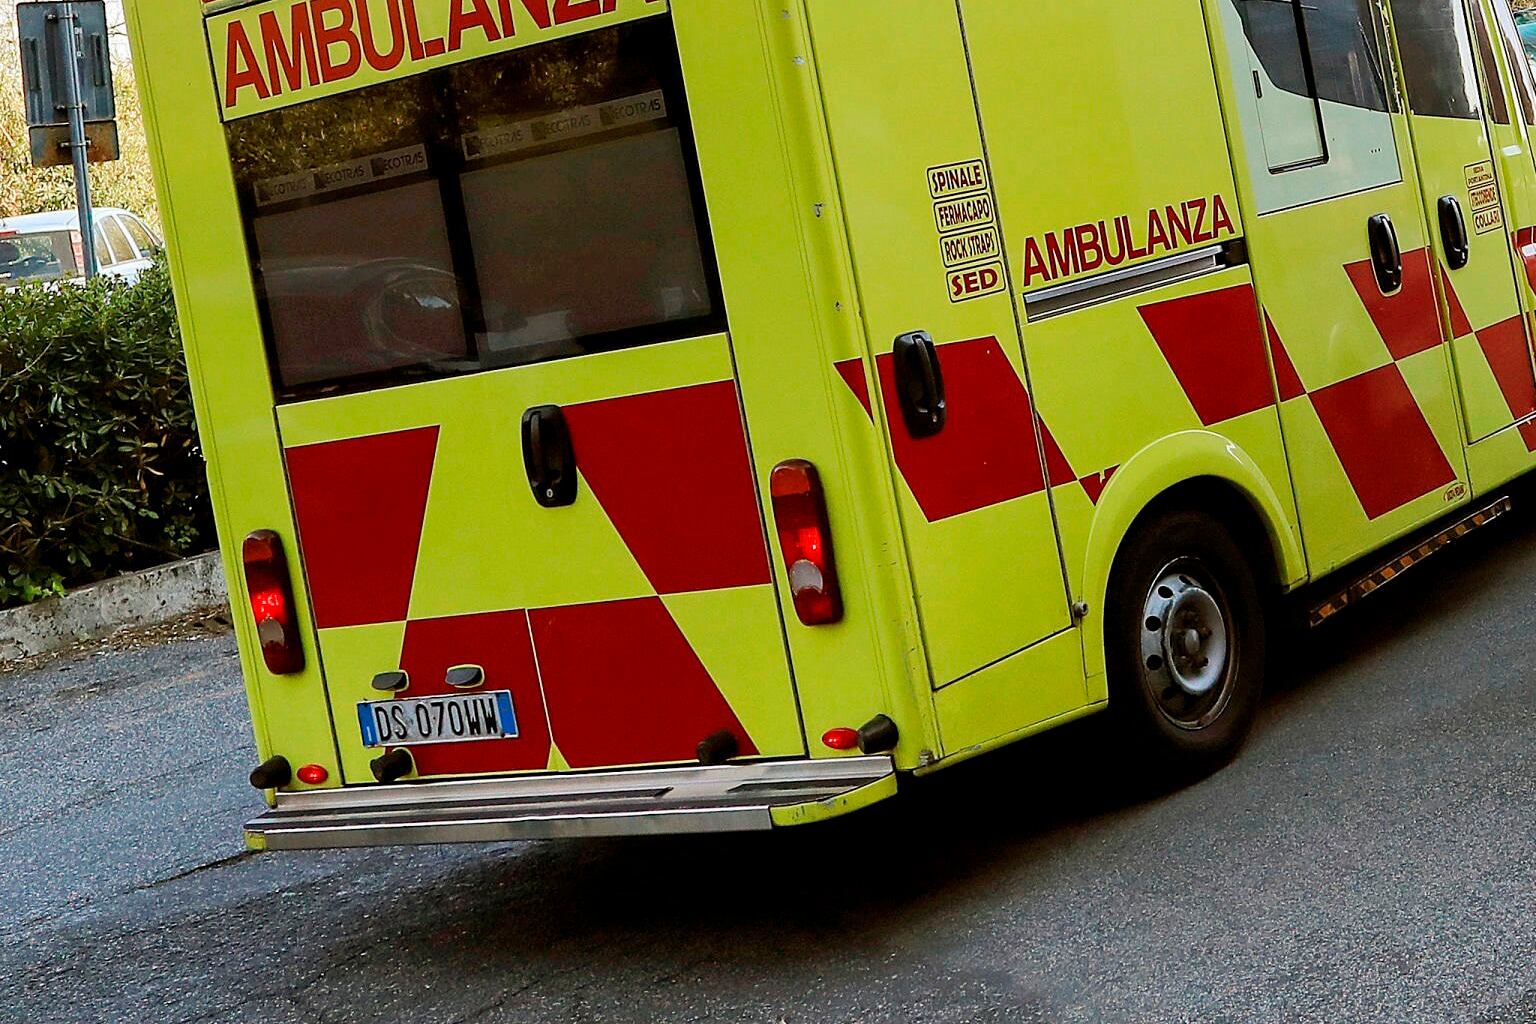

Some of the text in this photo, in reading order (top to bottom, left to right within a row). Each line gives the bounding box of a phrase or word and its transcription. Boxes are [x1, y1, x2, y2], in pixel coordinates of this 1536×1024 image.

[931, 165, 983, 193] SPINALE
[938, 198, 990, 227] FERMACAPO
[1475, 210, 1500, 229] COLLARI
[944, 232, 995, 262] ROCK STRAPS
[1023, 194, 1235, 286] AMBULANZA
[951, 268, 998, 297] SED
[374, 705, 408, 741] DS
